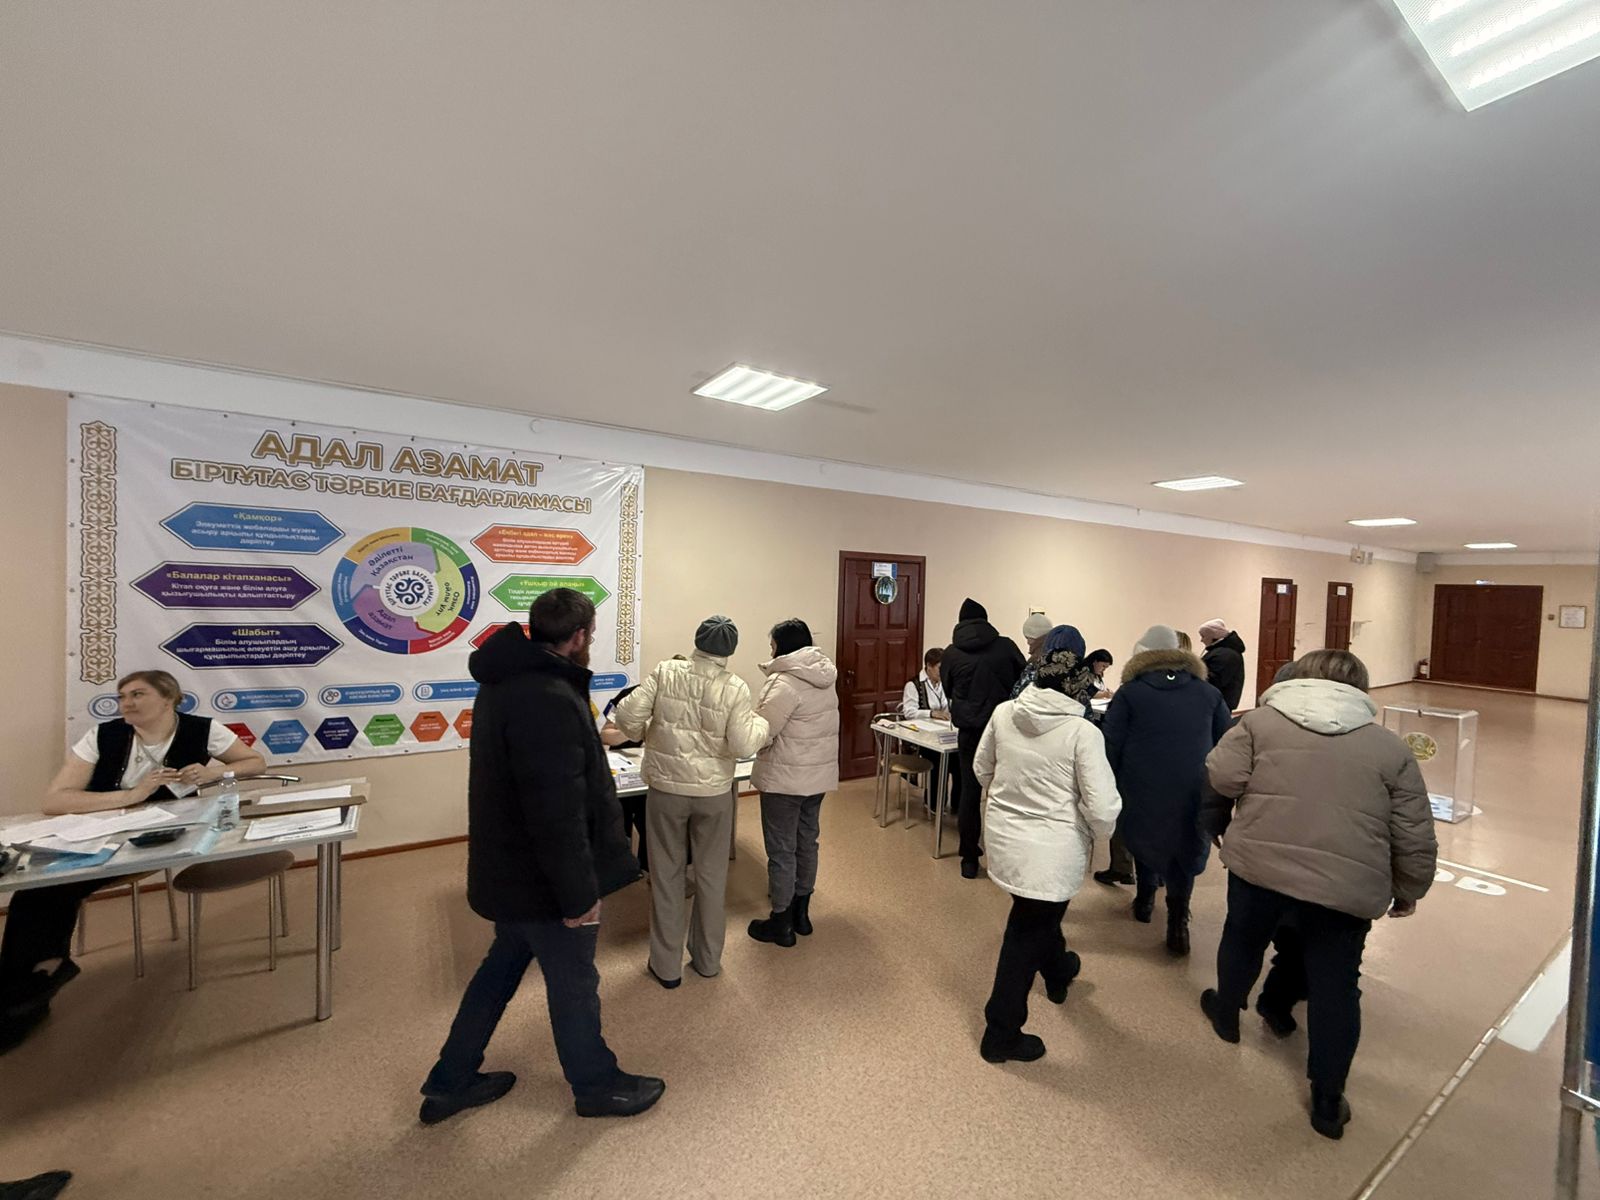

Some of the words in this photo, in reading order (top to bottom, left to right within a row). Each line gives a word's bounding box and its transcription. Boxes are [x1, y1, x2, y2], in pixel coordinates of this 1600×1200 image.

[252, 430, 383, 471] АДАЛ
[390, 447, 543, 487] АЗАМАТ
[171, 458, 310, 490] БІРТҰТАС
[312, 473, 413, 500] ТӘРБИЕ
[416, 481, 591, 515] БАҒДАРЛАМАСЫ
[368, 546, 404, 567] Әділетті
[370, 555, 414, 577] Қазақстан
[166, 571, 221, 582] «Балалар
[223, 572, 292, 582] кітапханасы»
[171, 583, 193, 591] Кітап
[232, 628, 281, 637] «Шабыт»
